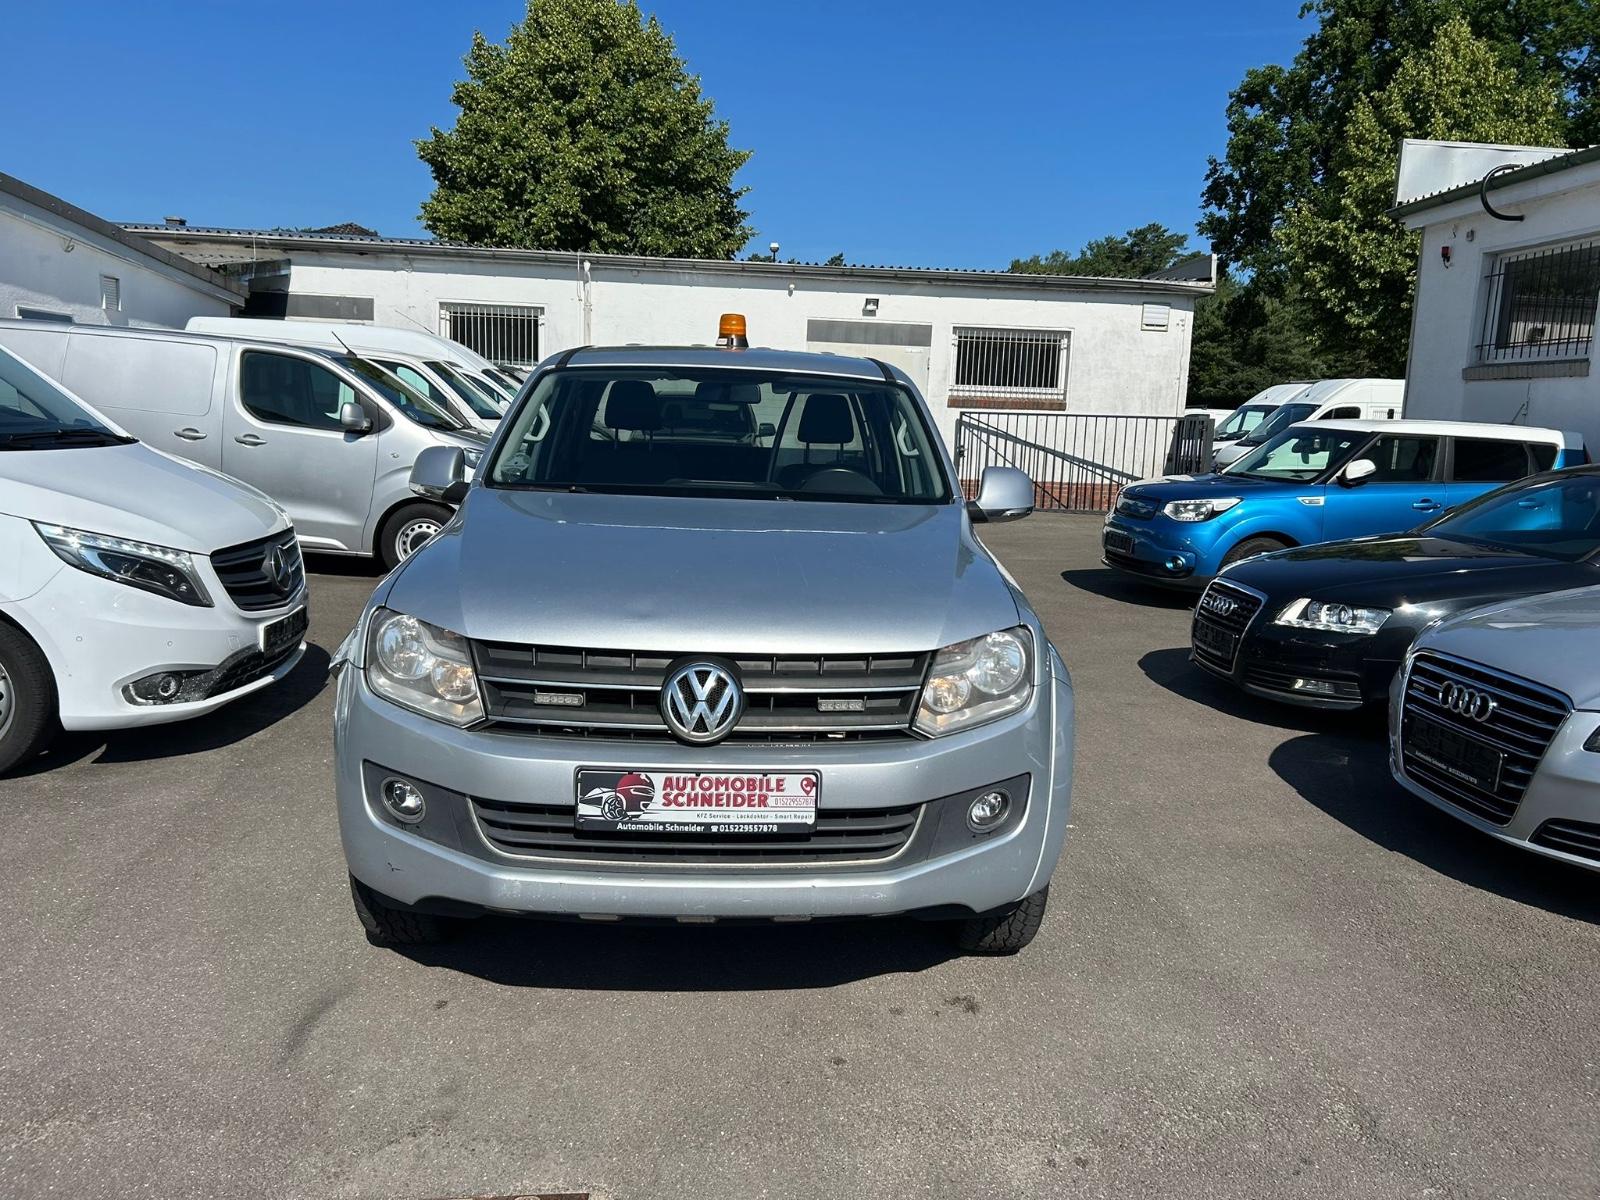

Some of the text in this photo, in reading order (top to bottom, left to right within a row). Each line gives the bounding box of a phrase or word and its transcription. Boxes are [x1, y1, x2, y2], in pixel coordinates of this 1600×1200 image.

[662, 775, 786, 792] AUTOMOBILE
[661, 792, 769, 808] SCHNEIDER
[616, 822, 664, 832] Automobile
[665, 823, 705, 833] Schneider
